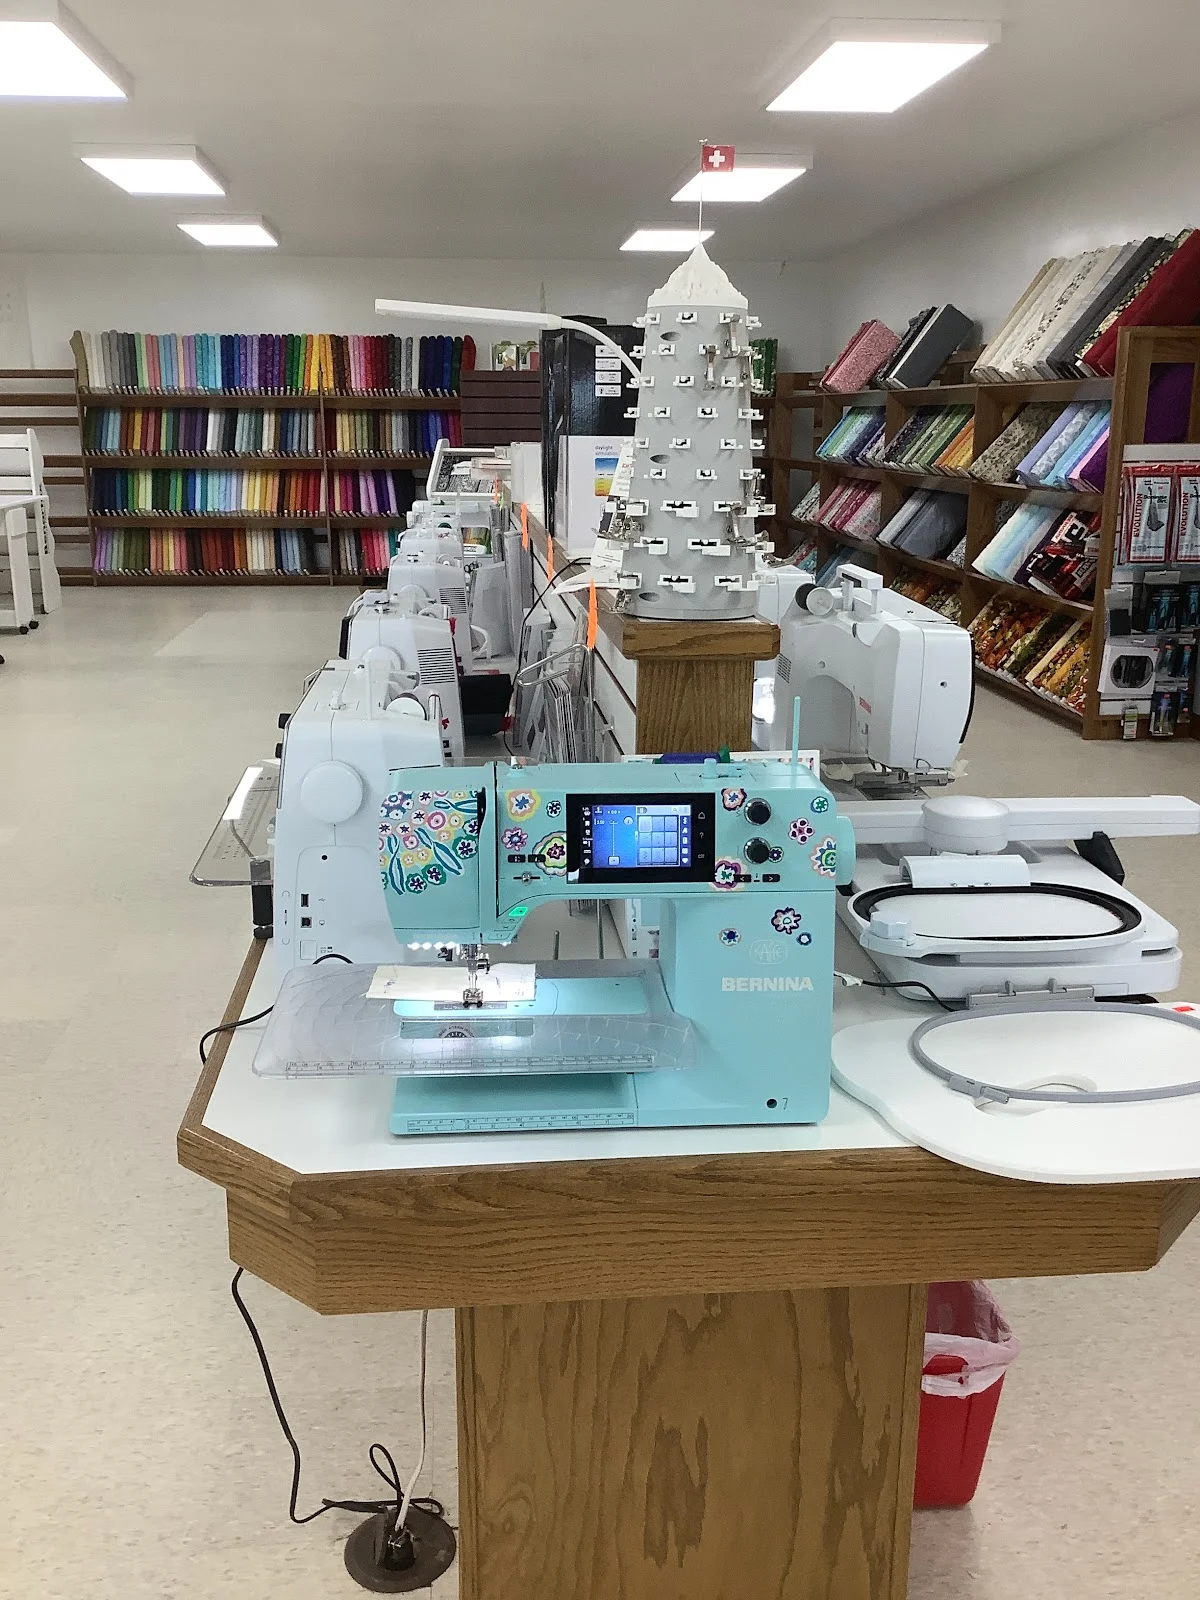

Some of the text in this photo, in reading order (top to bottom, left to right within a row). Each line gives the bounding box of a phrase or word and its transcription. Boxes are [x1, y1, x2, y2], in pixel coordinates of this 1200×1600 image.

[1133, 493, 1143, 537] EVOLUTION
[1180, 492, 1189, 537] EVOLUTION
[721, 977, 814, 992] BERNINA
[782, 1097, 788, 1110] 7
